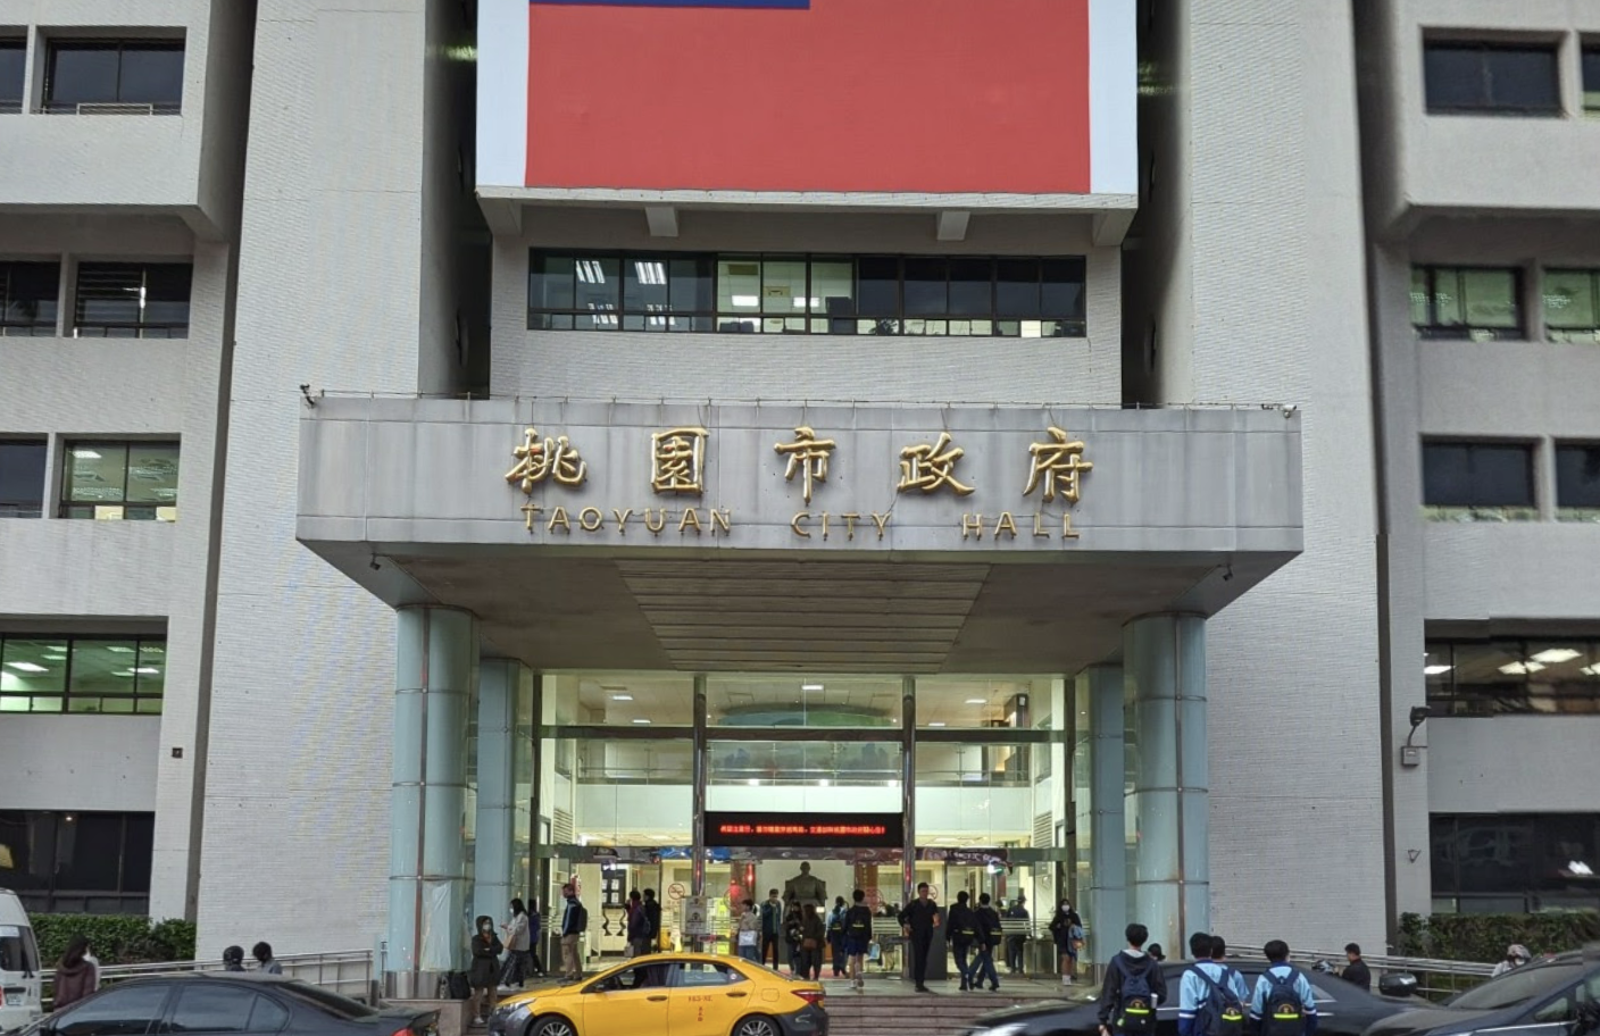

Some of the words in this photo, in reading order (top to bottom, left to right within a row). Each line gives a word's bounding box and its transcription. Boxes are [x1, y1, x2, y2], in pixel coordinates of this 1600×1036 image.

[506, 427, 1093, 503] 桃園市政府
[521, 505, 731, 534] TAOYUAN
[791, 512, 891, 539] CITY
[962, 512, 1080, 539] HALL
